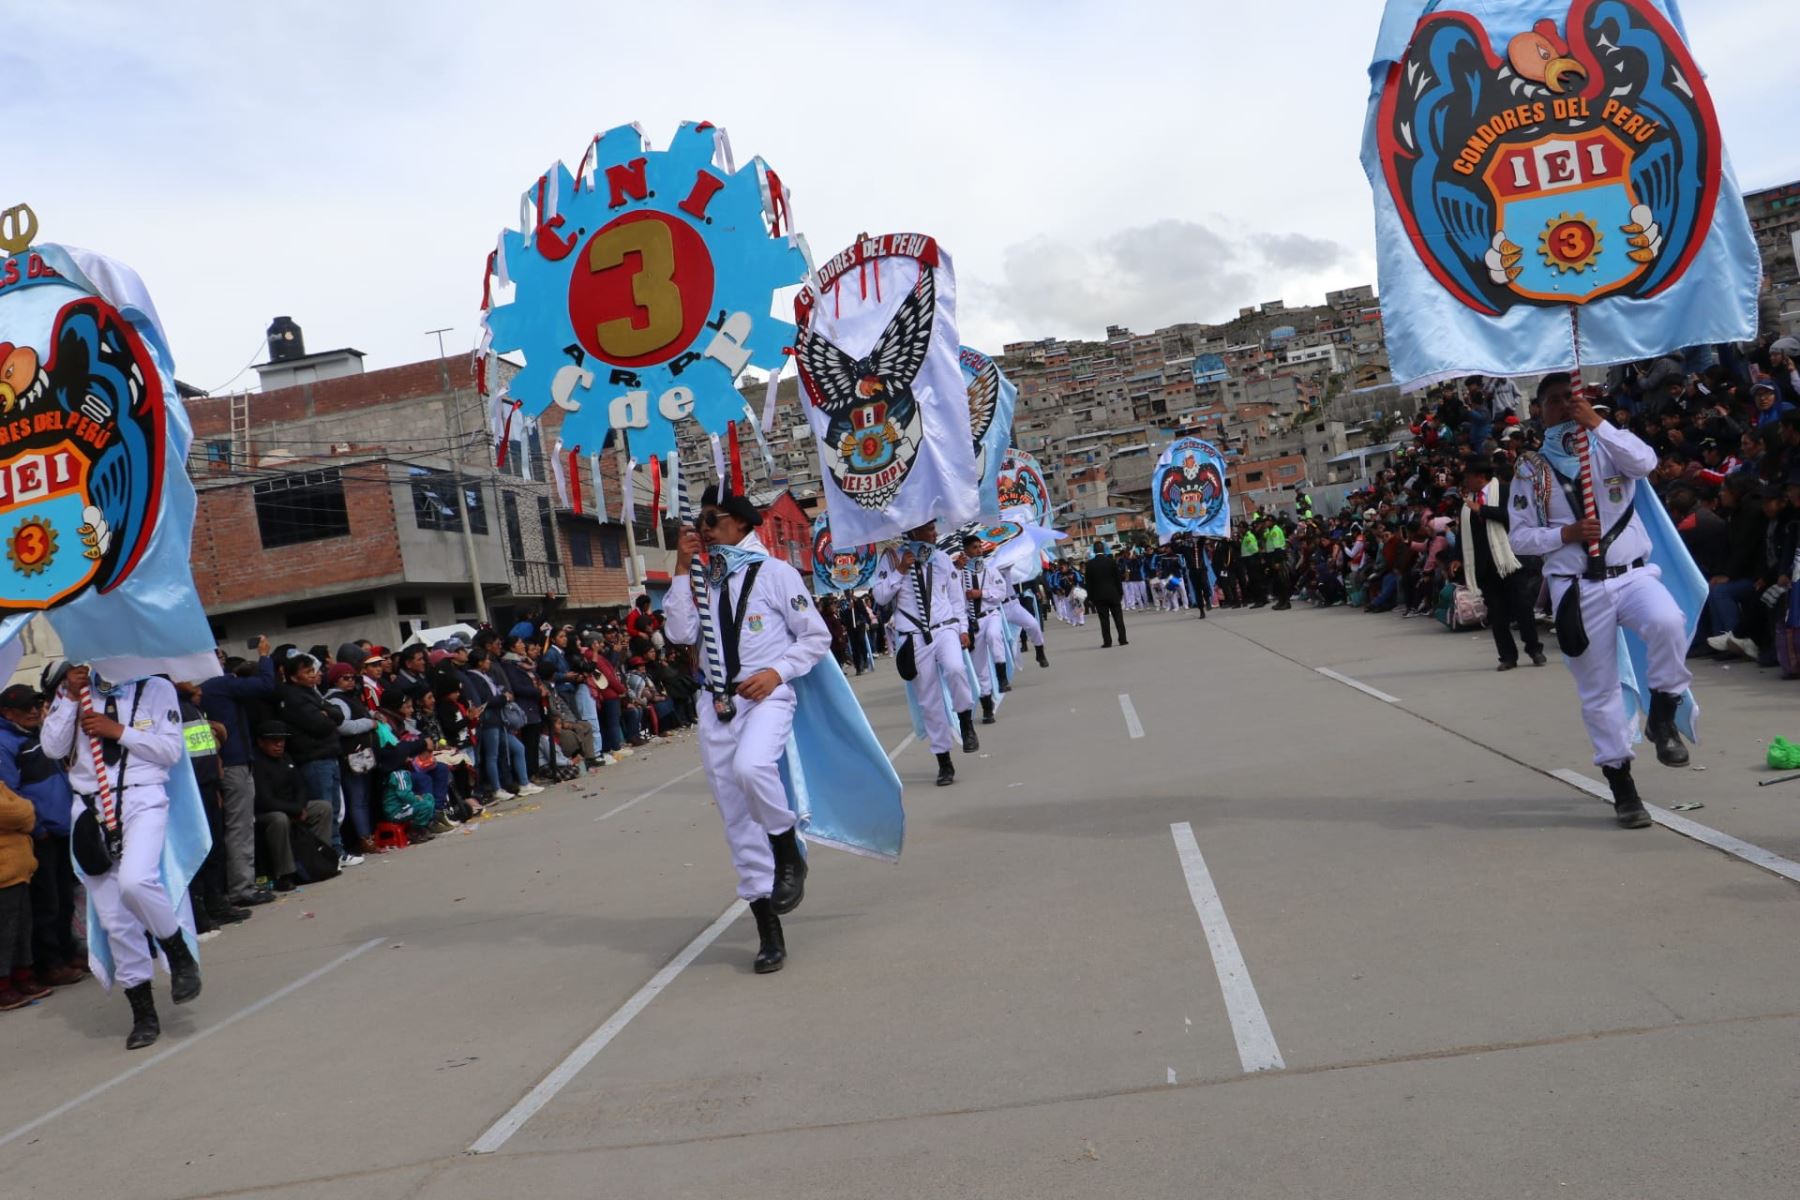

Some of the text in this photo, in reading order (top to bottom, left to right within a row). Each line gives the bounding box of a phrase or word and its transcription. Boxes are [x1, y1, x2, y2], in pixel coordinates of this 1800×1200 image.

[1452, 97, 1660, 175] CONDORES DEL PERÚ
[1510, 144, 1608, 187] IEI
[862, 237, 887, 258] DEL
[1559, 226, 1586, 258] 3
[589, 219, 684, 357] 3
[33, 410, 63, 433] DEL
[65, 410, 116, 449] PERÚ
[20, 525, 44, 564] 3
